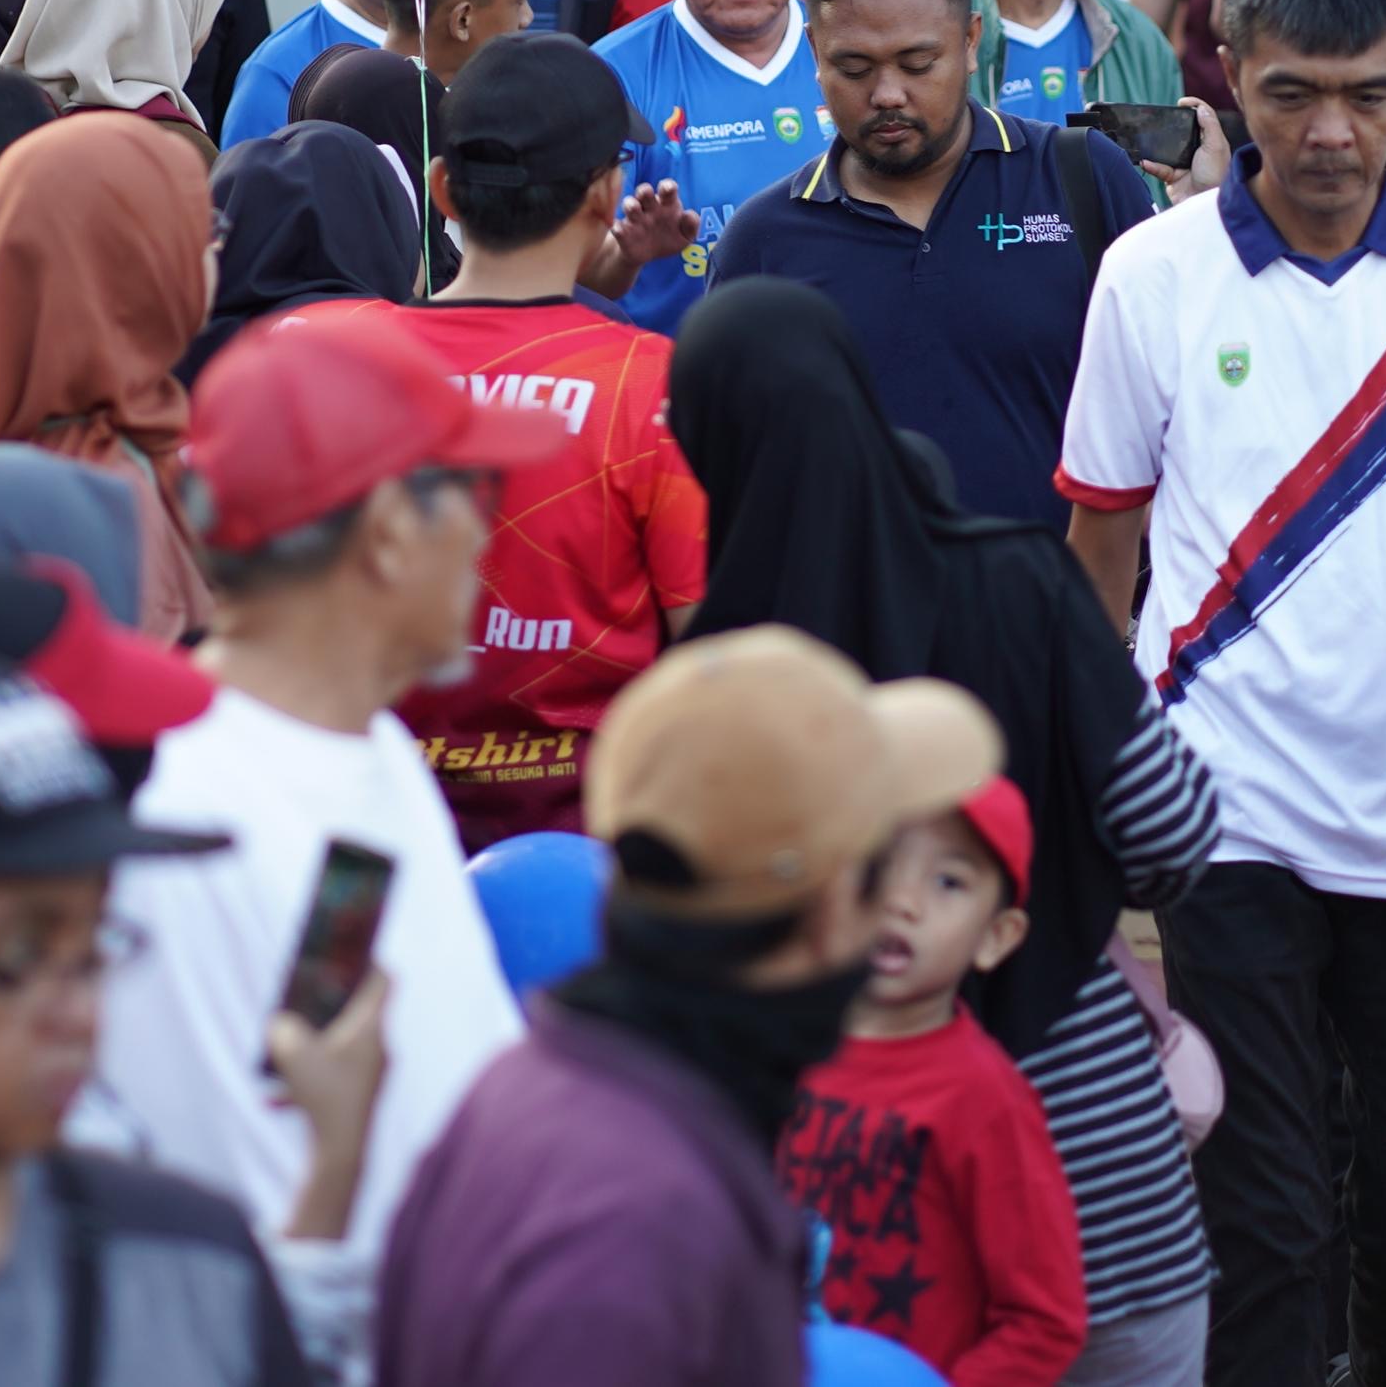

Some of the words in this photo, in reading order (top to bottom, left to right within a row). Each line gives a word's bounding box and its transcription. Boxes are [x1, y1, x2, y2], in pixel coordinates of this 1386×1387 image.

[1023, 214, 1060, 225] HUMAS
[1024, 223, 1073, 234] PROTOKOL
[1025, 232, 1068, 243] SUMSEL
[496, 765, 544, 783] SESUKA
[548, 762, 576, 777] HATI
